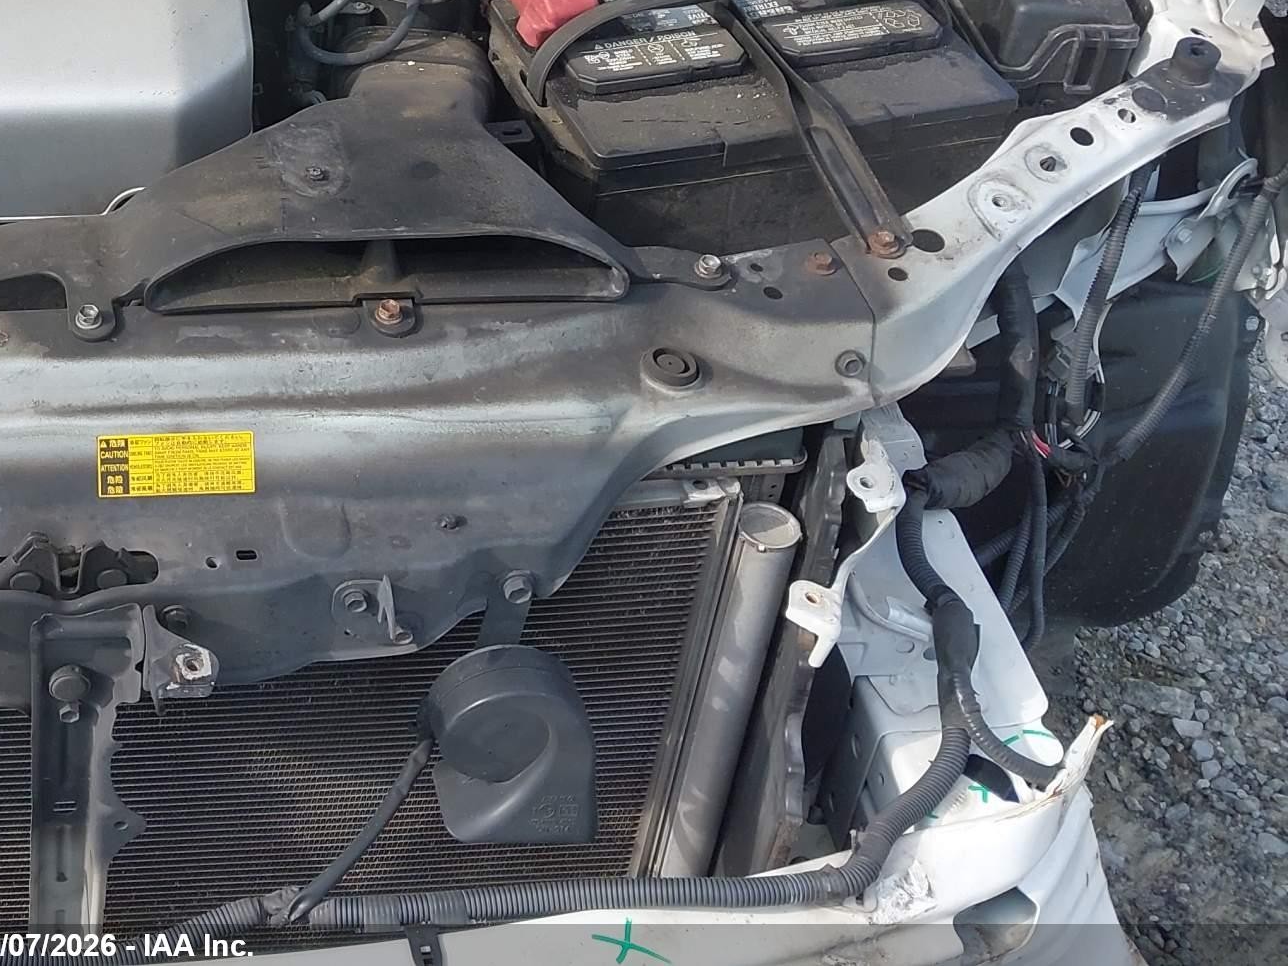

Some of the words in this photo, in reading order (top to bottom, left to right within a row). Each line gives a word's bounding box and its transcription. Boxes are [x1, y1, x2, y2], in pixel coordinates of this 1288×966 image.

[605, 37, 647, 48] DANGER
[657, 31, 696, 41] POISON
[100, 450, 129, 459] CAUTION
[100, 464, 129, 472] ATTENTION
